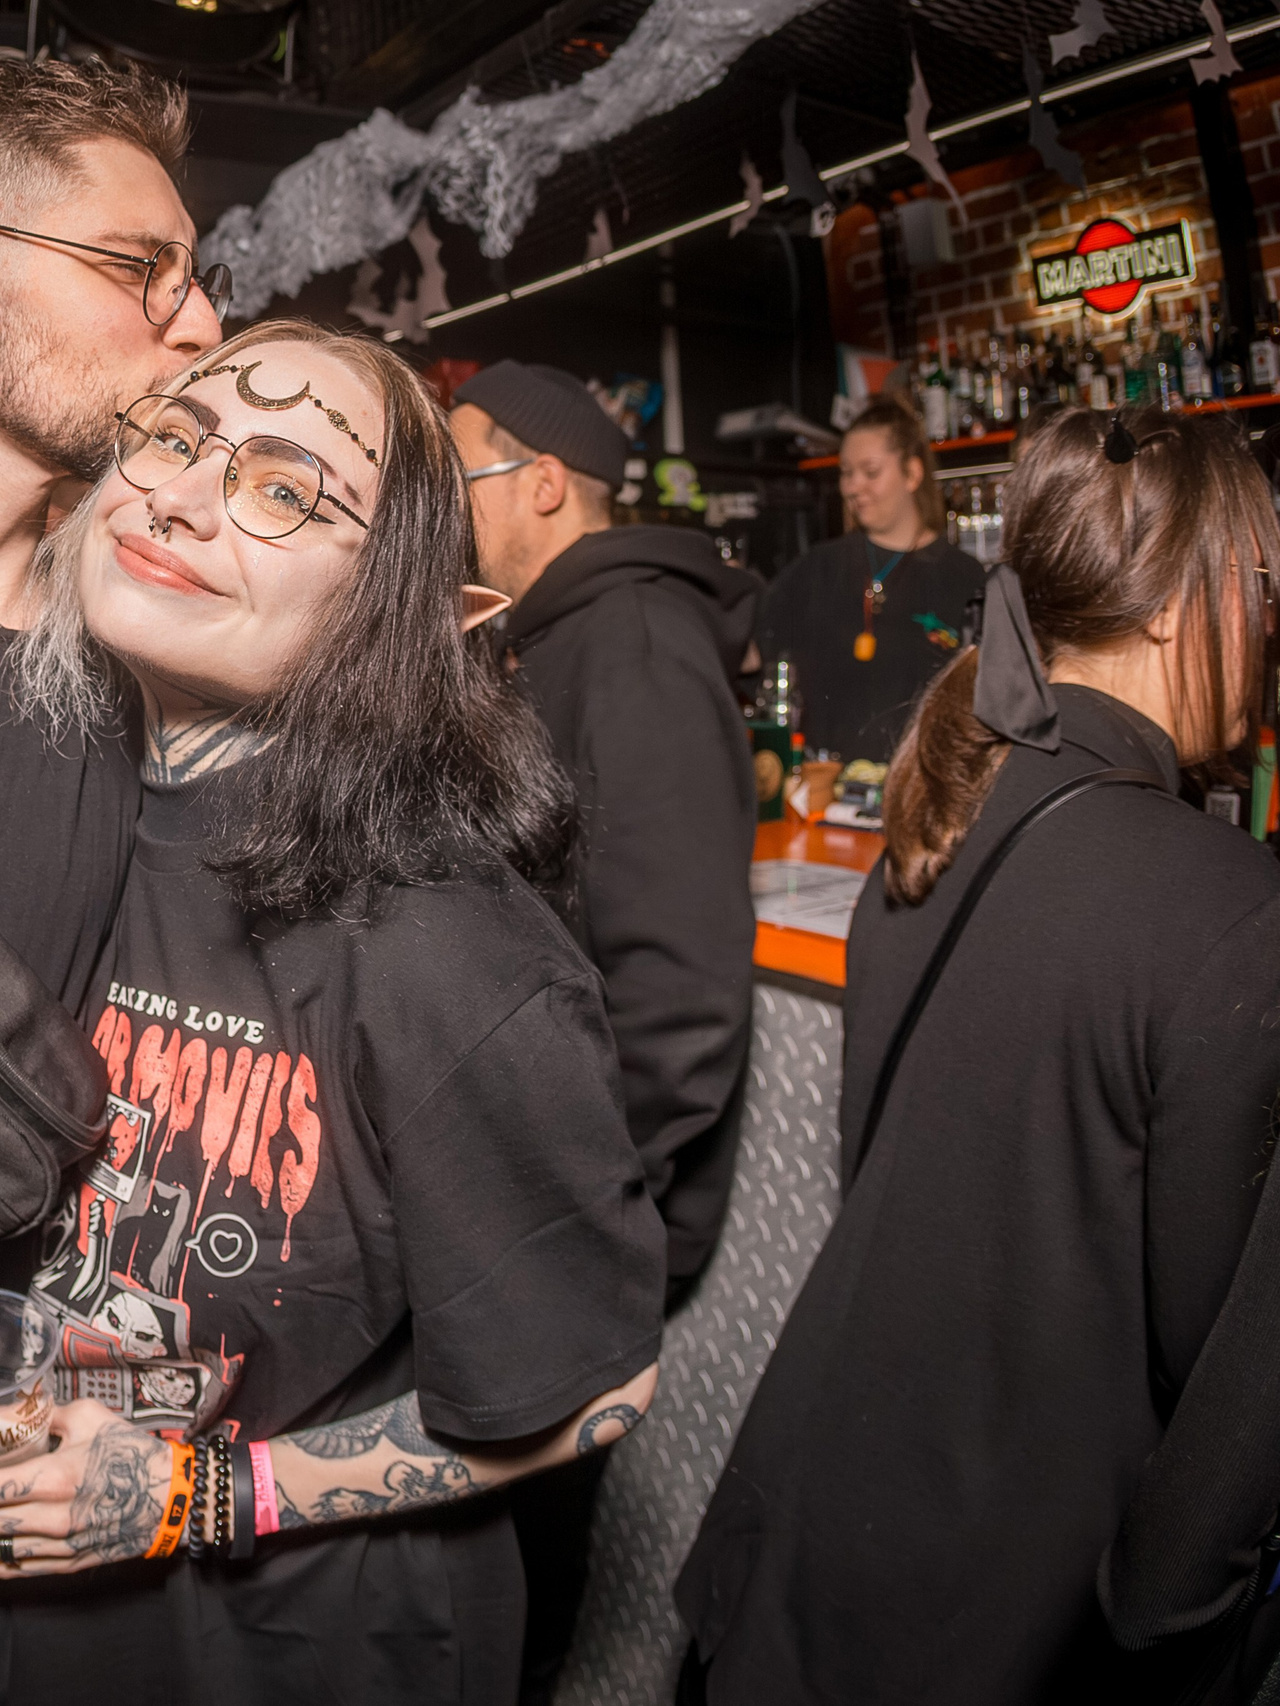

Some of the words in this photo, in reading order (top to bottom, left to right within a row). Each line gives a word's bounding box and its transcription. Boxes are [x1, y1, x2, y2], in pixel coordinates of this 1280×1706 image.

[1036, 233, 1185, 299] MARTINI
[106, 981, 179, 1021] EAKING
[183, 1005, 266, 1044] LOVE
